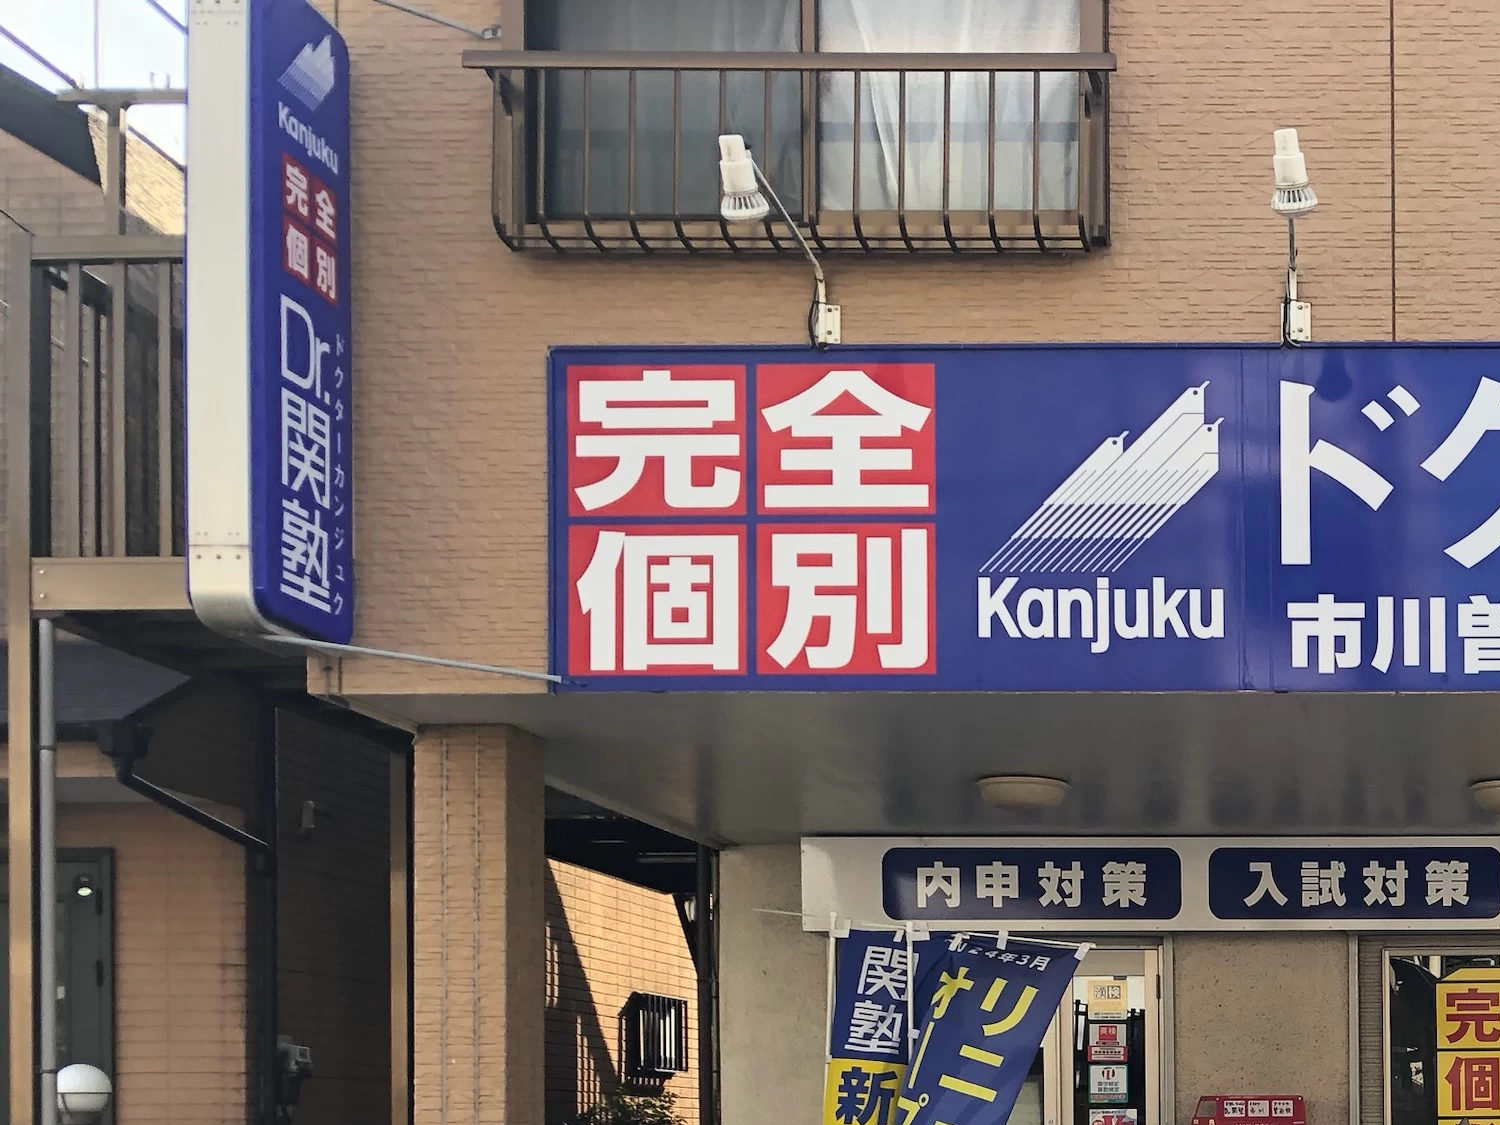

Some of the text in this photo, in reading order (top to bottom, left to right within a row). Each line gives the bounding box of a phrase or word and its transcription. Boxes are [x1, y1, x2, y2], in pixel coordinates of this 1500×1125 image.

[278, 101, 339, 174] Kanjuku
[286, 163, 336, 240] 完全
[286, 224, 336, 300] 個別
[280, 293, 331, 614] Dr.関塾
[334, 333, 345, 616] ドクターカンジュク
[574, 369, 933, 511] 完全
[576, 528, 928, 671] 個別
[978, 577, 1226, 653] Kanjuku
[916, 860, 1149, 910] 内申対策
[1243, 860, 1471, 908] 入試対策
[845, 945, 919, 1055] 関塾
